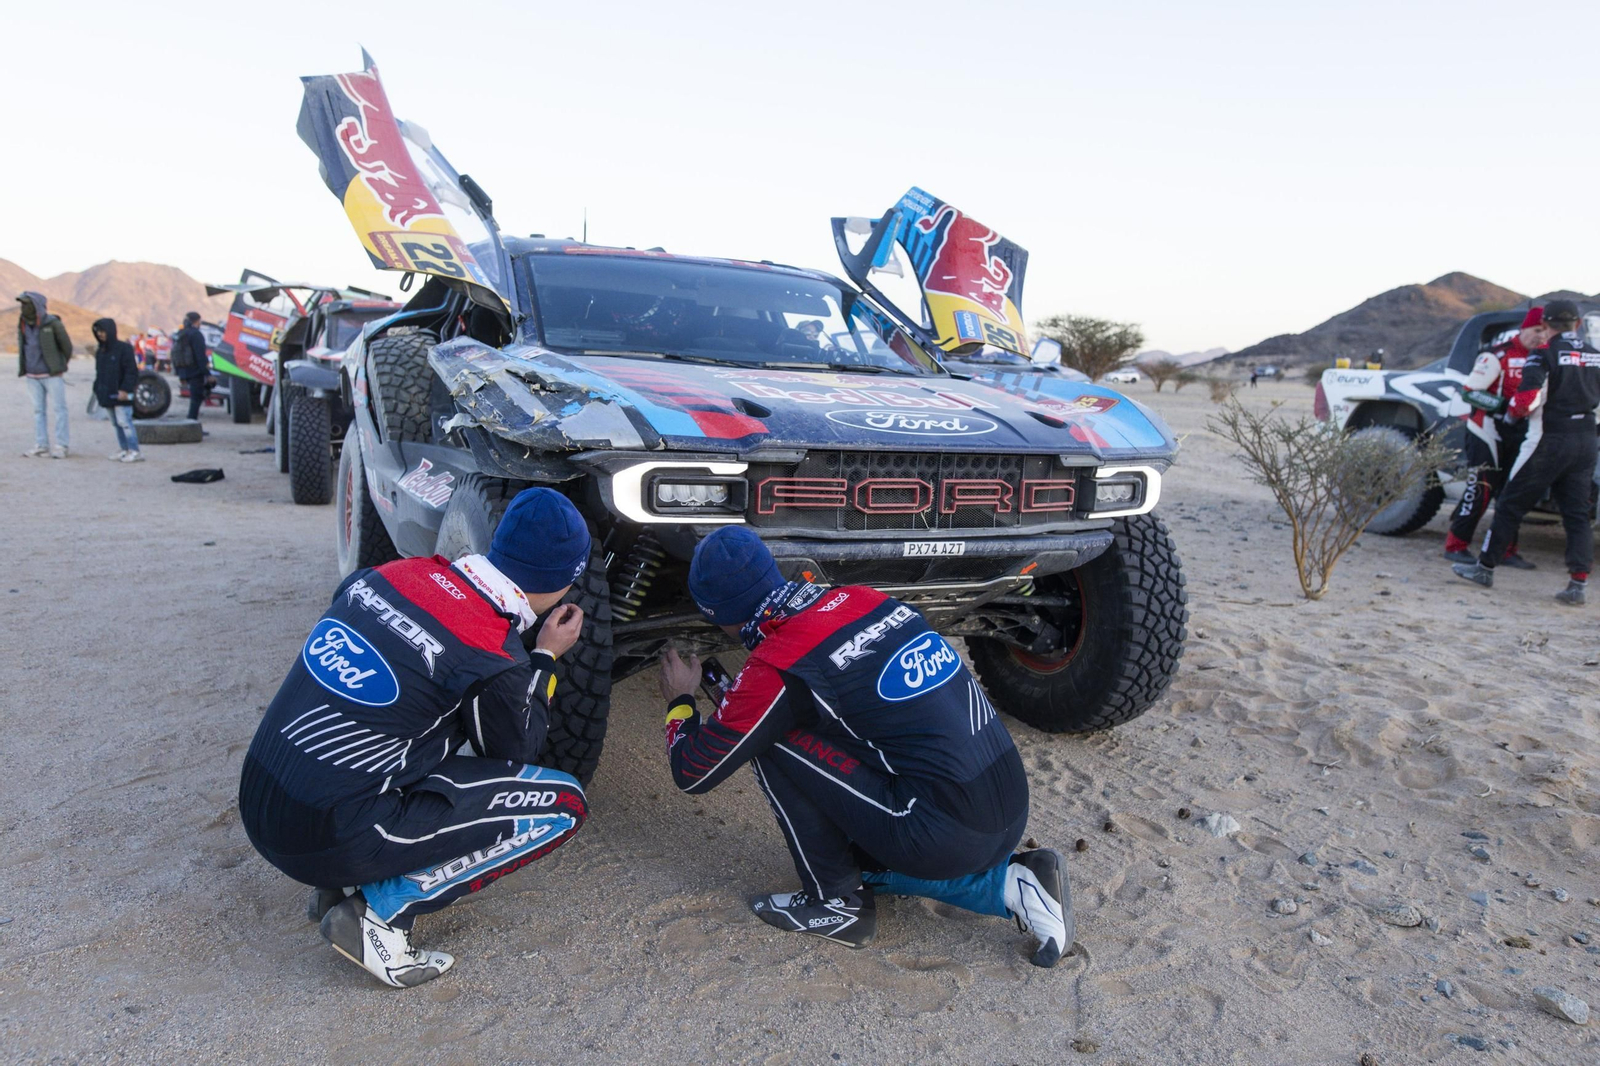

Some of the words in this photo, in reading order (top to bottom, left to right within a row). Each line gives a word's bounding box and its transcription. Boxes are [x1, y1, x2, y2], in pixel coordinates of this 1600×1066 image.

[865, 410, 969, 431] Ford
[755, 476, 1076, 516] FORD
[907, 543, 938, 555] PX74
[940, 543, 963, 555] AZT
[428, 571, 467, 601] sparco
[343, 577, 446, 679] RAPTOR
[829, 604, 921, 671] RAPTO
[308, 626, 377, 690] Ford
[899, 638, 958, 689] Ford
[808, 915, 844, 928] sparco
[366, 928, 392, 963] sparco
